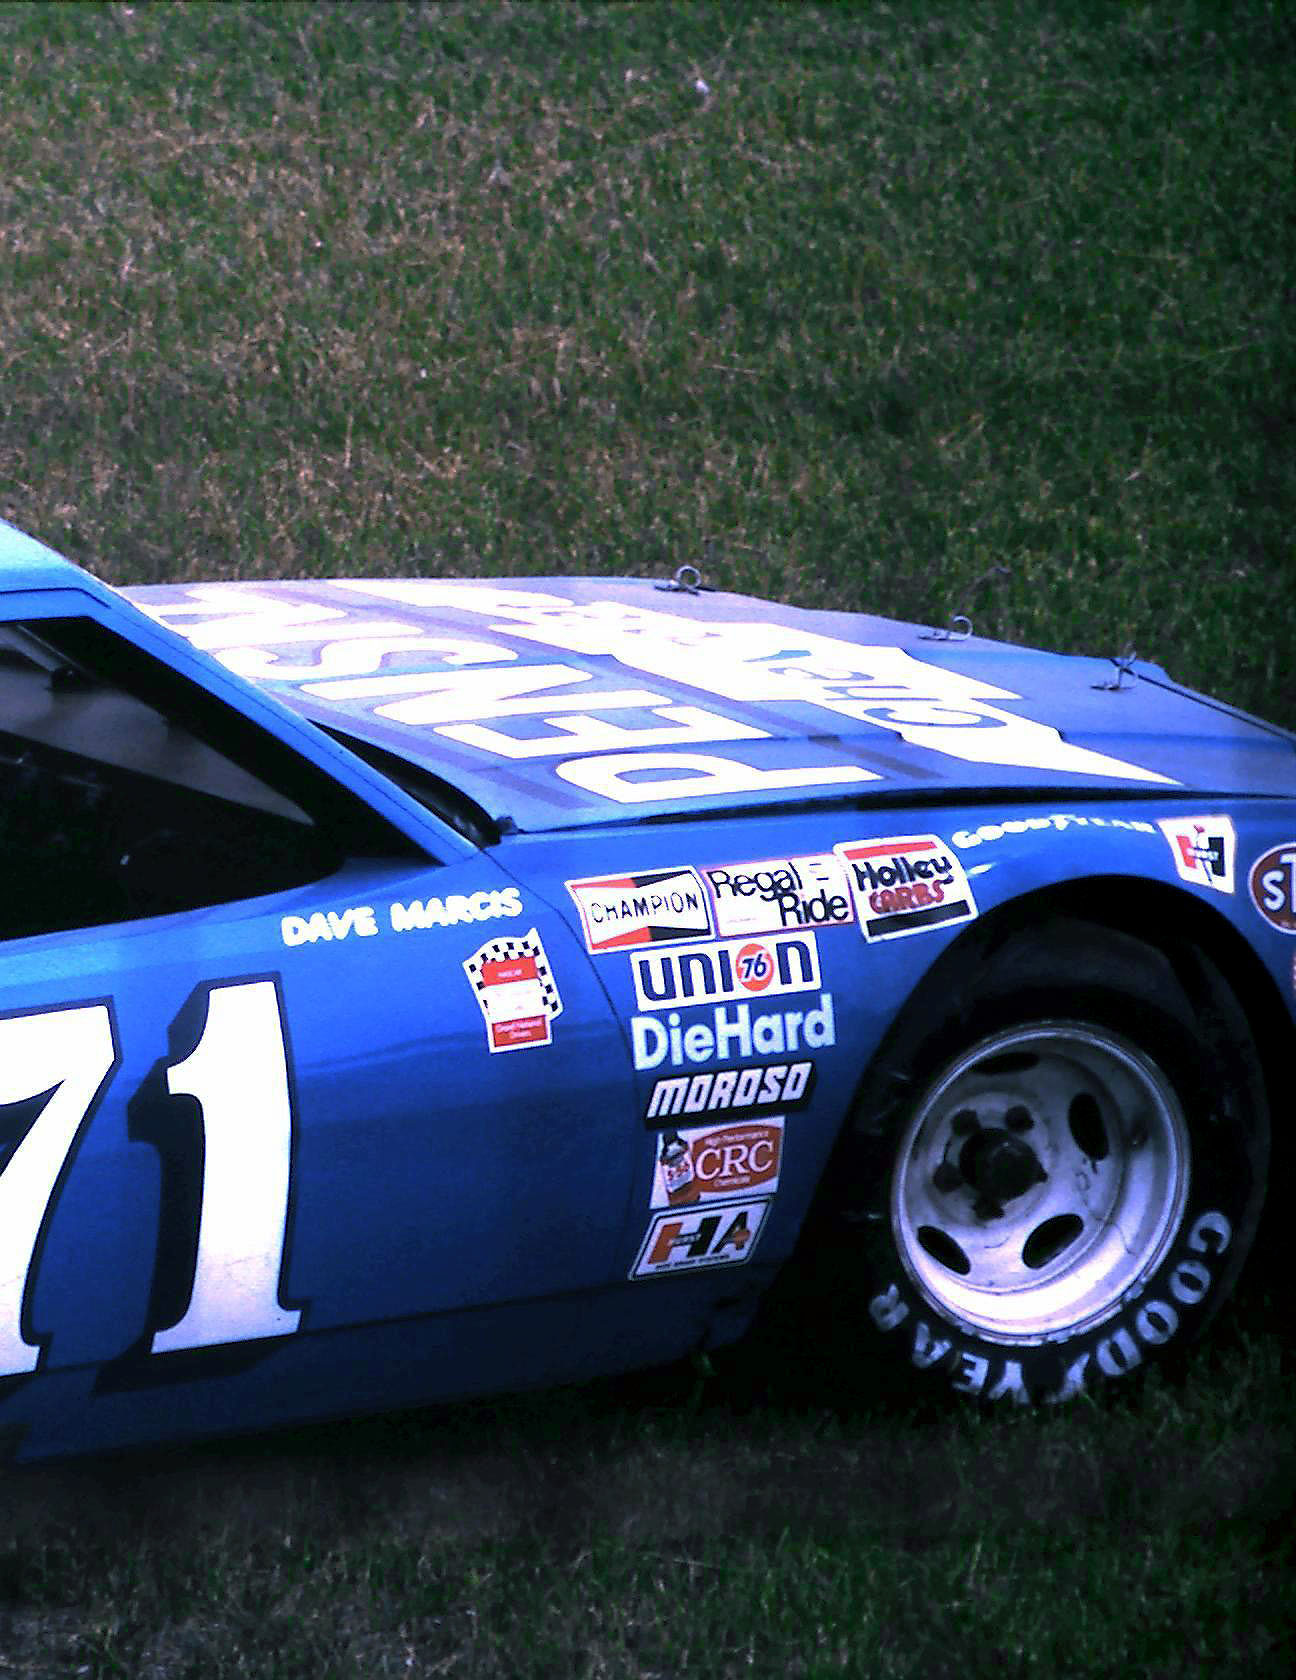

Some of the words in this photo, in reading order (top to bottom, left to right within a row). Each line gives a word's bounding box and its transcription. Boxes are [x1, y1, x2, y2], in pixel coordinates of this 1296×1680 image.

[706, 861, 803, 902] Regal
[851, 854, 954, 892] Holley
[591, 891, 699, 924] CHAMPION
[777, 888, 849, 927] Ride
[869, 877, 946, 914] CARBS
[280, 905, 379, 947] DAVE
[389, 887, 523, 932] MARCIS
[630, 993, 836, 1071] DieHard
[695, 1139, 774, 1181] CRC
